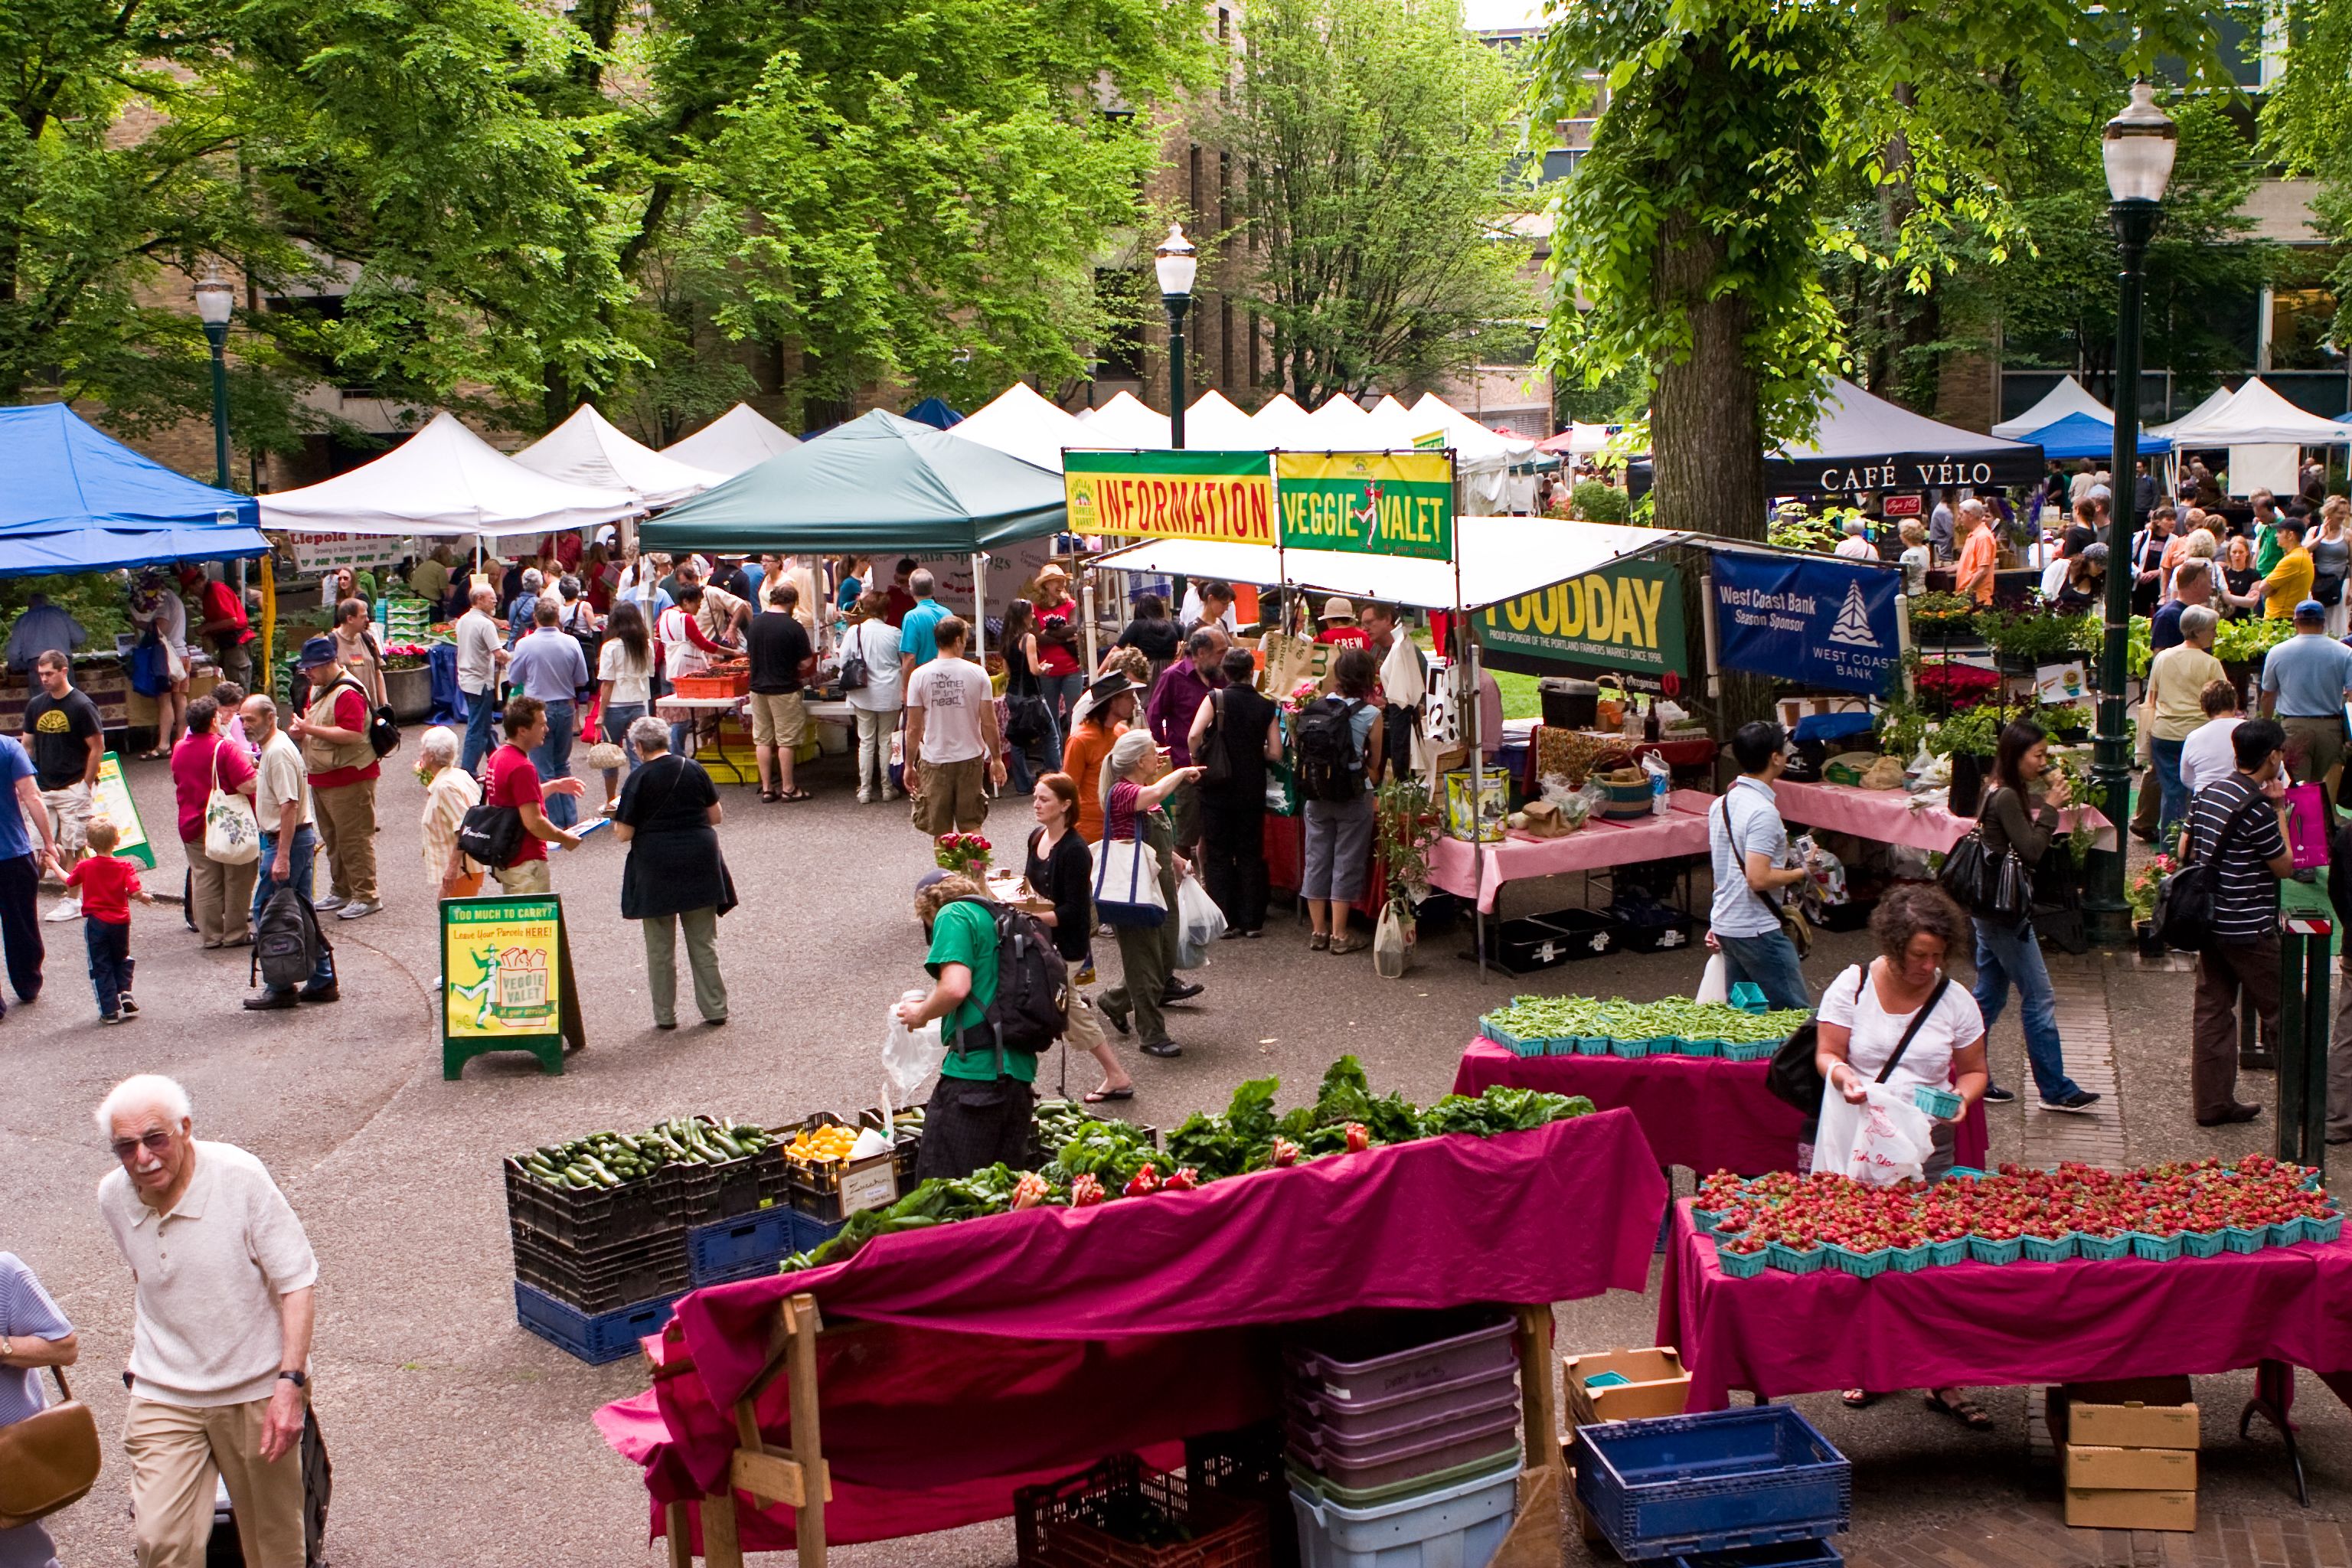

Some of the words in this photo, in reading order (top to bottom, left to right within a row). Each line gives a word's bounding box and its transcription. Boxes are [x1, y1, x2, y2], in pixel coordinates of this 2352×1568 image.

[1821, 457, 1896, 491] CAFÉ
[1916, 455, 1991, 485] VÉLO
[1096, 479, 1269, 538] INFORMATION
[1282, 492, 1359, 537] VEGGIE
[1378, 495, 1443, 543] VALET
[290, 532, 347, 546] Liepold
[1720, 586, 1750, 606] West
[1753, 589, 1785, 610] Coast
[1788, 593, 1816, 615] Bank
[1735, 609, 1767, 626] Season
[1770, 613, 1805, 632] Sponsor
[1334, 637, 1364, 650] CREW
[1489, 629, 1506, 641] PROUD
[1507, 632, 1531, 645] SPONSOR
[1532, 635, 1539, 645] OF
[1540, 636, 1550, 648] THE
[1551, 639, 1579, 652] PORTLAND
[1580, 642, 1605, 655] FARMERS
[1606, 646, 1628, 658] MARKET
[1630, 649, 1647, 662] SINCE
[1813, 647, 1847, 662] WEST
[1836, 665, 1873, 681] BANK
[1627, 675, 1661, 690] Oregonian
[454, 910, 472, 920] TOO
[475, 909, 501, 920] MUCH
[504, 909, 515, 919] TO
[518, 906, 552, 918] CARRY?
[453, 929, 475, 939] Leave
[478, 929, 495, 939] Your
[496, 927, 524, 937] Parcels
[526, 927, 552, 938] HERE!
[502, 973, 544, 989] VEGGIE
[507, 987, 540, 1004] VALET
